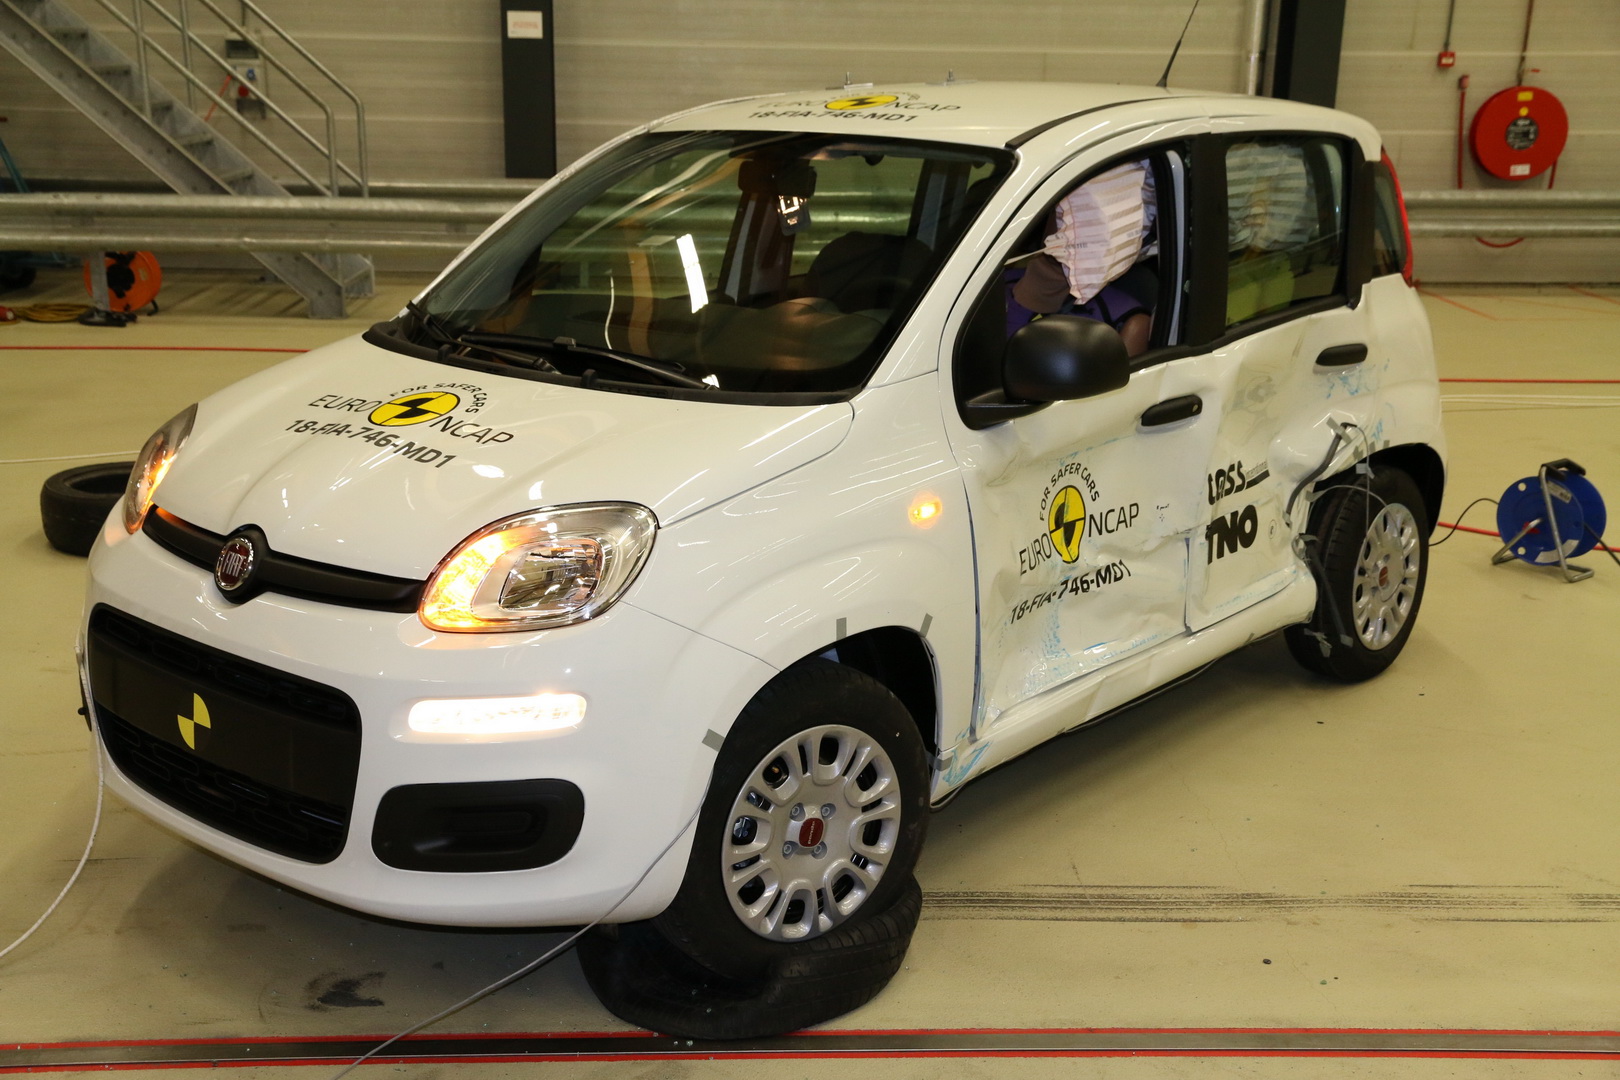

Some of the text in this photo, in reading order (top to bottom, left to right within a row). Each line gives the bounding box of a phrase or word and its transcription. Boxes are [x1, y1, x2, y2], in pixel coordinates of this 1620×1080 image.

[748, 110, 919, 122] 18-FIA-746-MD1
[884, 101, 962, 112] NCAP
[308, 394, 514, 446] EURO NCAP
[389, 382, 488, 414] FOR SAFER CARS
[285, 419, 457, 468] 18-FIA-746-MD1
[1039, 462, 1100, 521] FOR SAFER CARS
[1018, 502, 1140, 576] EURO NCAP
[1205, 504, 1258, 565] TNO
[222, 551, 247, 578] FIAT
[1010, 559, 1132, 624] 18-FIA-746-MD1
